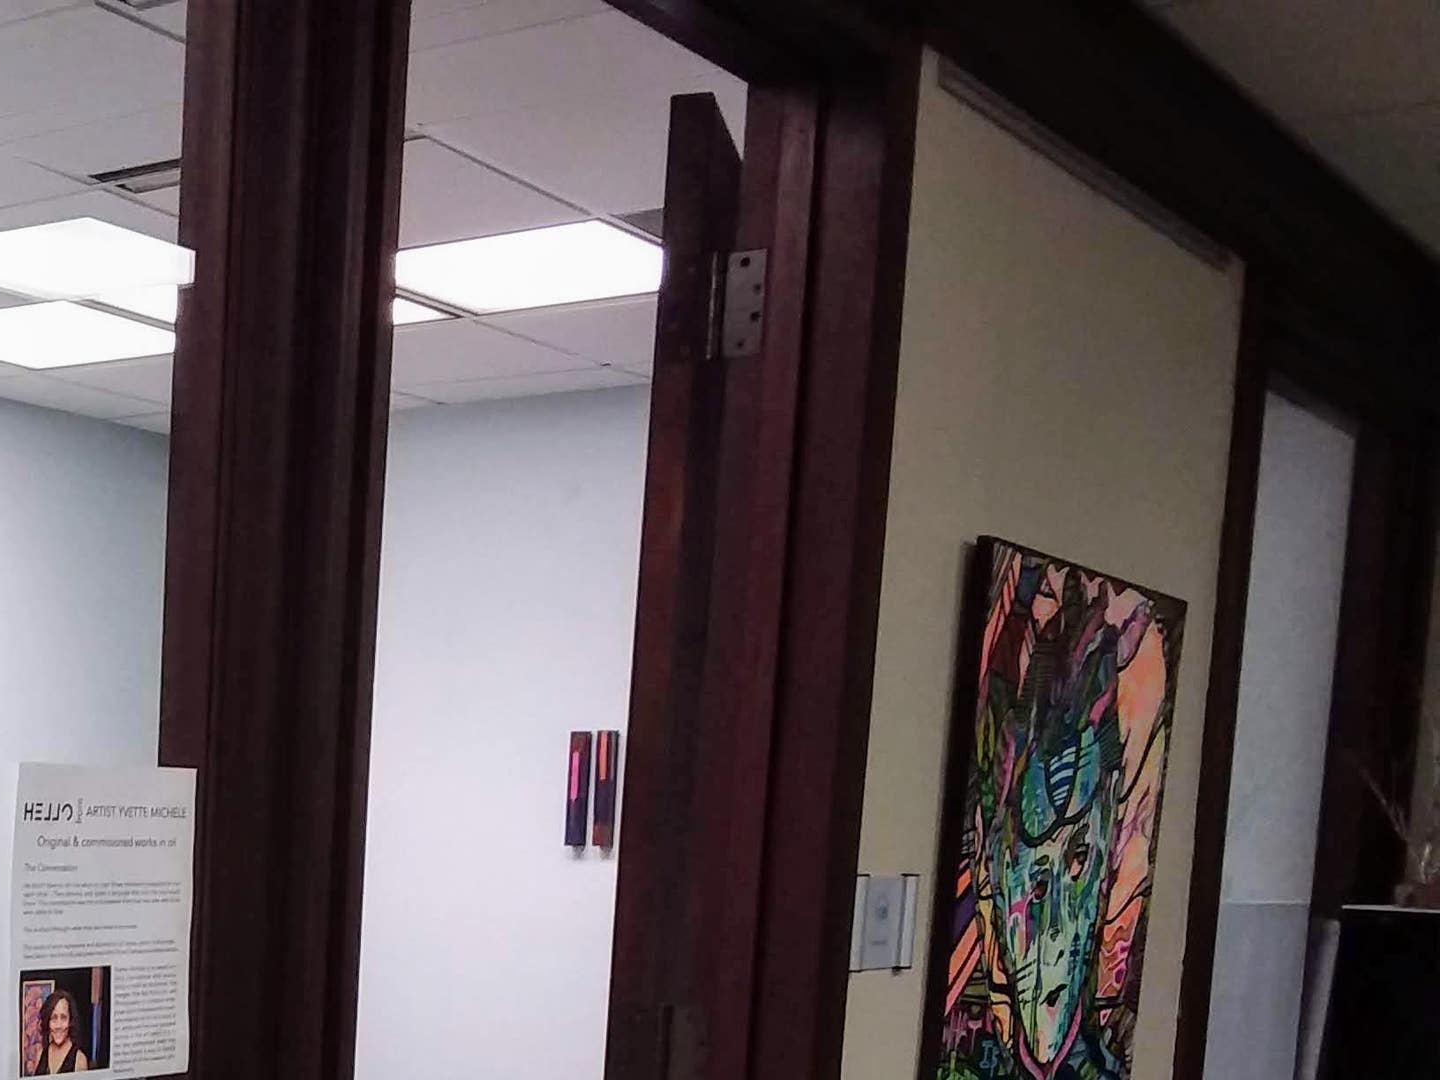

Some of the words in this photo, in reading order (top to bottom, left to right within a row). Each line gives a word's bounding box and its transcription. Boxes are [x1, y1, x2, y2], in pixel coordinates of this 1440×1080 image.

[86, 805, 117, 818] ARTIST
[118, 805, 148, 819] YVETTE
[149, 805, 188, 819] MICHELE
[37, 834, 71, 850] Original
[72, 834, 80, 848] &
[134, 836, 156, 848] works
[159, 838, 167, 848] in
